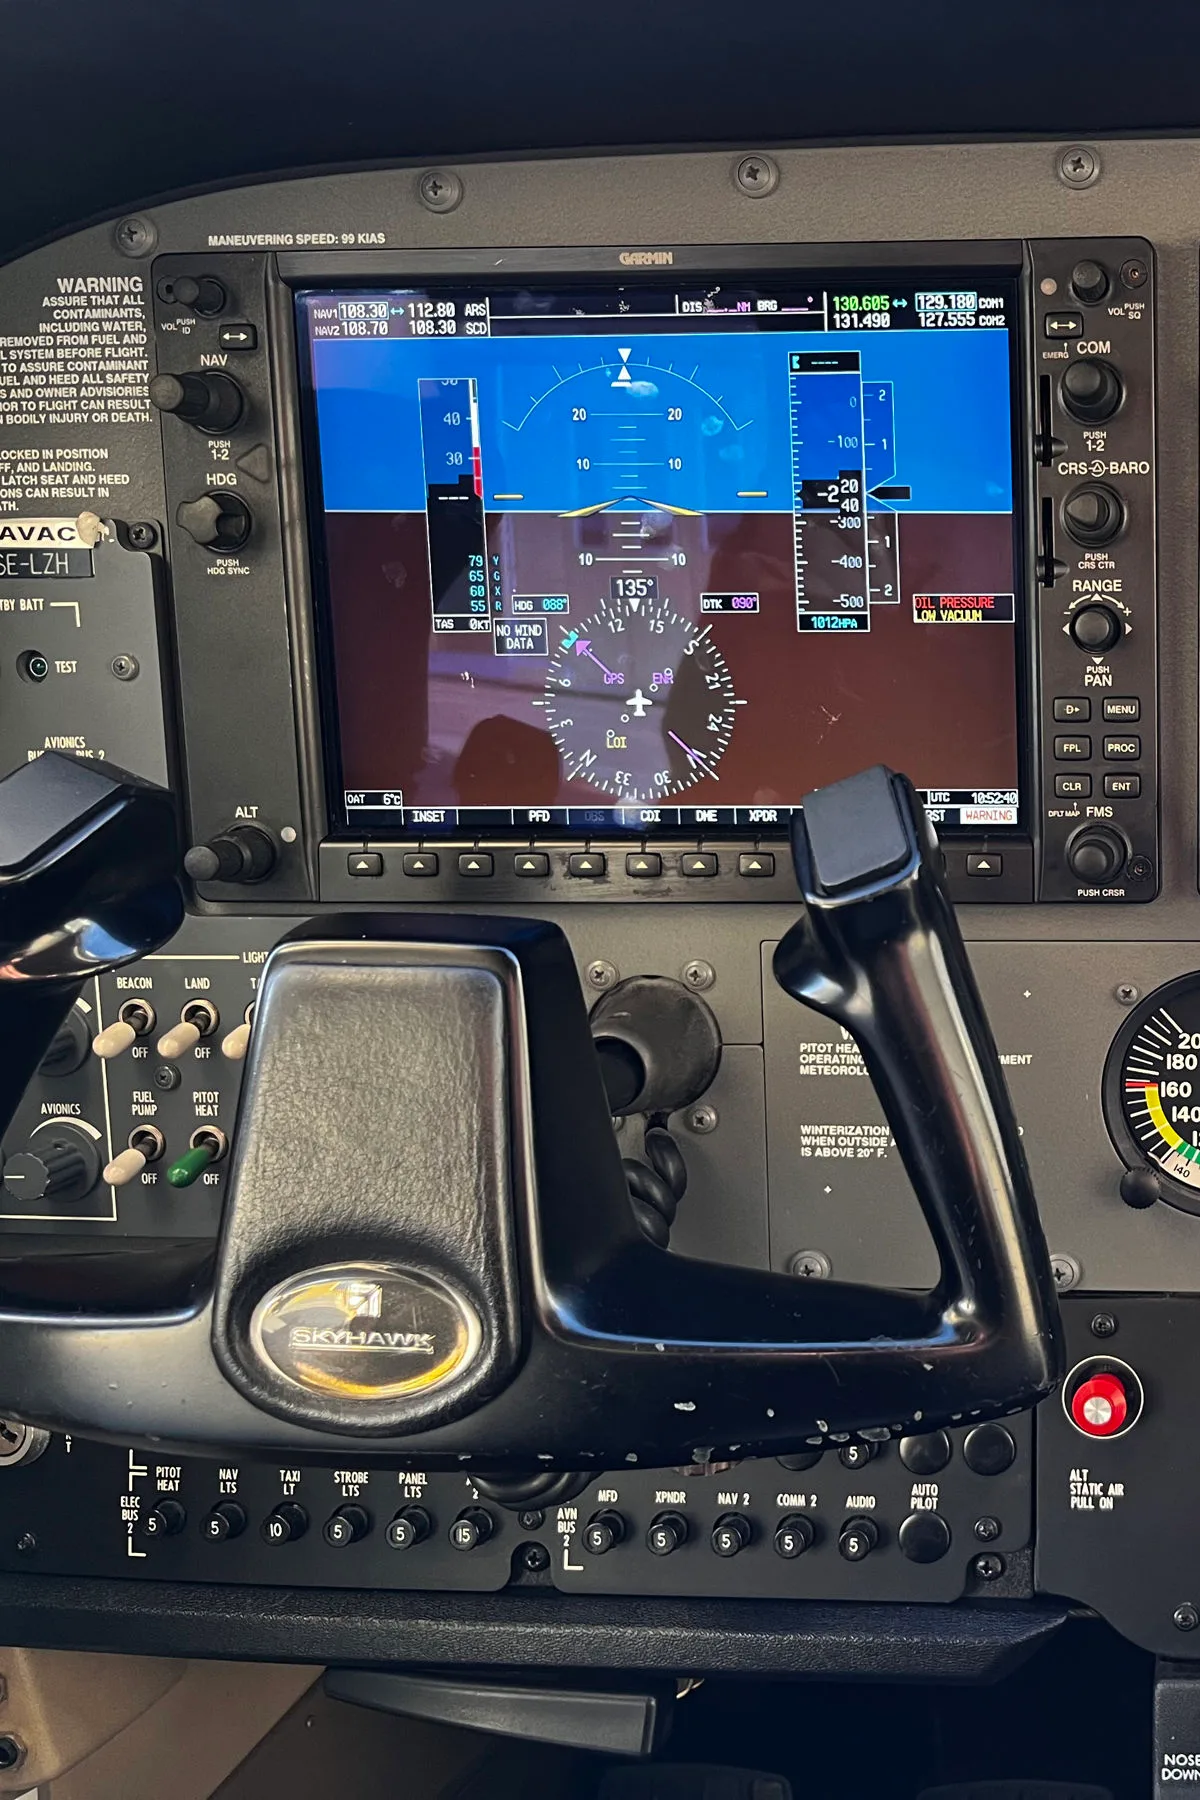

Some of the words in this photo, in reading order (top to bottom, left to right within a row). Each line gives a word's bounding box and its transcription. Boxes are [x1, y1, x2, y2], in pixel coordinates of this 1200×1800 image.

[208, 234, 293, 246] MANEUVERING
[296, 234, 338, 245] SPEED:
[342, 233, 355, 244] 99
[358, 233, 385, 244] KIAS
[620, 252, 672, 265] GARMIN
[58, 278, 143, 293] WARNING
[43, 296, 87, 307] ASSURE
[90, 296, 119, 306] THAT
[123, 296, 144, 305] ALL
[833, 297, 890, 310] 130.605
[919, 295, 974, 309] 129.180
[979, 298, 1003, 309] COM1
[53, 308, 145, 320] CONTAMINANTS,
[314, 308, 338, 319] NAV1
[341, 304, 386, 318] 108.30
[408, 302, 455, 318] 112.80
[465, 304, 486, 316] ARS
[40, 322, 99, 333] INCLUDING
[102, 321, 146, 333] WATER,
[0, 335, 53, 346] REMOVED
[56, 335, 88, 346] FROM
[92, 335, 119, 345] FUEL
[123, 334, 146, 344] AND
[9, 348, 53, 359] SYSTEM
[57, 348, 101, 358] BEFORE
[104, 347, 147, 358] FLIGHT.
[1077, 341, 1111, 354] COM
[200, 355, 227, 367] NAV
[6, 413, 46, 424] BODILY
[49, 413, 87, 423] INJURY
[91, 413, 108, 423] OR
[112, 412, 152, 423] DEATH.
[1058, 463, 1087, 475] CRS
[1110, 462, 1150, 474] BARO
[207, 474, 236, 485] HDG
[617, 579, 653, 595] 135°
[1073, 580, 1122, 592] RANGE
[916, 597, 935, 608] OIL
[940, 597, 995, 608] PRESSURE
[916, 611, 936, 621] LOW
[941, 610, 982, 621] VACUUM
[497, 625, 510, 637] NO
[515, 625, 542, 637] WIND
[506, 638, 534, 649] DATA
[55, 661, 77, 673] TEST
[604, 673, 624, 684] GPS
[1085, 675, 1112, 687] PAN
[1107, 705, 1135, 714] MENU
[45, 737, 85, 749] AVIONICS
[1108, 743, 1135, 753] PROC
[1112, 782, 1130, 791] ENT
[931, 793, 950, 803] UTC
[972, 792, 1017, 804] 10:52:40
[235, 807, 258, 818] ALT
[413, 811, 445, 822] INSET
[529, 811, 550, 822] PFD
[640, 811, 661, 822] CDI
[696, 811, 717, 822] DME
[749, 811, 777, 822] XPDR
[966, 810, 1012, 821] WARNING
[1086, 807, 1113, 818] FMS
[1078, 889, 1100, 897] PUSH
[117, 978, 152, 989] BEACON
[185, 978, 210, 989] LAND
[1161, 1081, 1192, 1097] 160
[133, 1092, 154, 1102] FUEL
[193, 1092, 219, 1103] PITOT
[41, 1104, 81, 1115] AVIONICS
[132, 1105, 157, 1116] PUMP
[195, 1105, 218, 1116] HEAT
[801, 1126, 890, 1136] WINTERIZATION
[801, 1136, 836, 1146] WHEN
[838, 1136, 887, 1146] OUTSIDE
[802, 1148, 812, 1157] IS
[815, 1148, 854, 1157] ABOVE
[877, 1148, 887, 1158] F.
[290, 1328, 436, 1347] SKYHAWK
[334, 1471, 368, 1484] STROBE
[399, 1473, 427, 1485] PANEL
[912, 1484, 938, 1496] AUTO
[1070, 1483, 1103, 1495] STATIC
[1108, 1484, 1124, 1495] AIR
[656, 1491, 686, 1503] XPNDR
[777, 1494, 805, 1506] COMM
[811, 1495, 817, 1507] 2
[846, 1496, 875, 1508] AUDIO
[911, 1498, 938, 1510] PILOT
